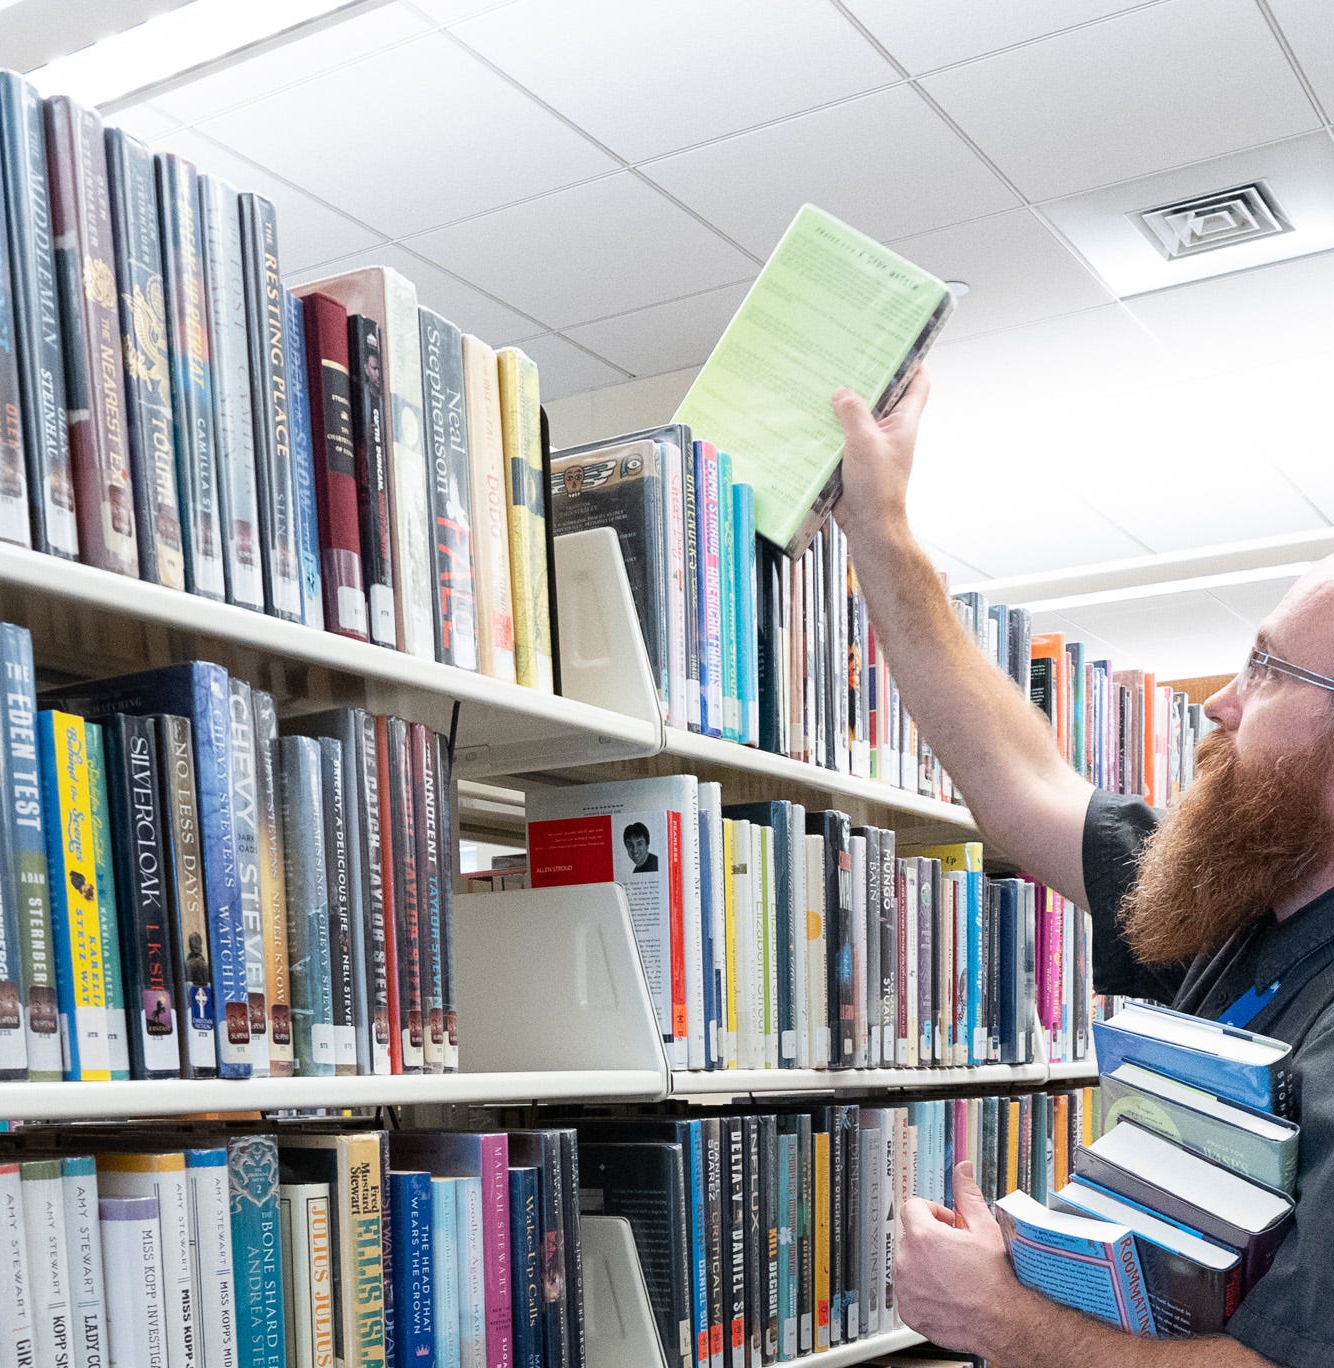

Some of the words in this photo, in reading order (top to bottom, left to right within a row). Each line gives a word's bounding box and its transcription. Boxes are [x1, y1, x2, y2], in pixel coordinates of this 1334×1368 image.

[264, 252, 284, 375] RESTING
[270, 376, 290, 458] PLACE
[424, 324, 449, 497] Stephenson
[442, 388, 467, 456] Neal
[6, 691, 36, 761] EDEN
[173, 742, 189, 778] NO
[213, 710, 227, 782] CHEVY
[228, 693, 255, 830] CHEVY
[12, 765, 41, 833] TEST
[129, 735, 161, 909] SILVERCLOAK
[178, 789, 195, 844] LESS
[218, 791, 235, 888] STEVENS
[552, 865, 573, 873] STROUD
[183, 854, 200, 913] DAYS
[491, 1145, 505, 1214] MARIAH
[730, 1131, 744, 1202] DELTA-V
[750, 1125, 759, 1232] INFLUX
[9, 1240, 26, 1318] STEWART
[141, 1230, 153, 1262] MISS
[309, 1206, 328, 1285] JULIUS
[494, 1220, 508, 1297] STEWART
[731, 1230, 744, 1301] DANIEL
[145, 1264, 157, 1299] KOPP
[246, 1245, 262, 1329] ANDREA
[411, 1285, 422, 1336] CROWN
[527, 1283, 540, 1330] Calls
[313, 1289, 332, 1368] JULIUS
